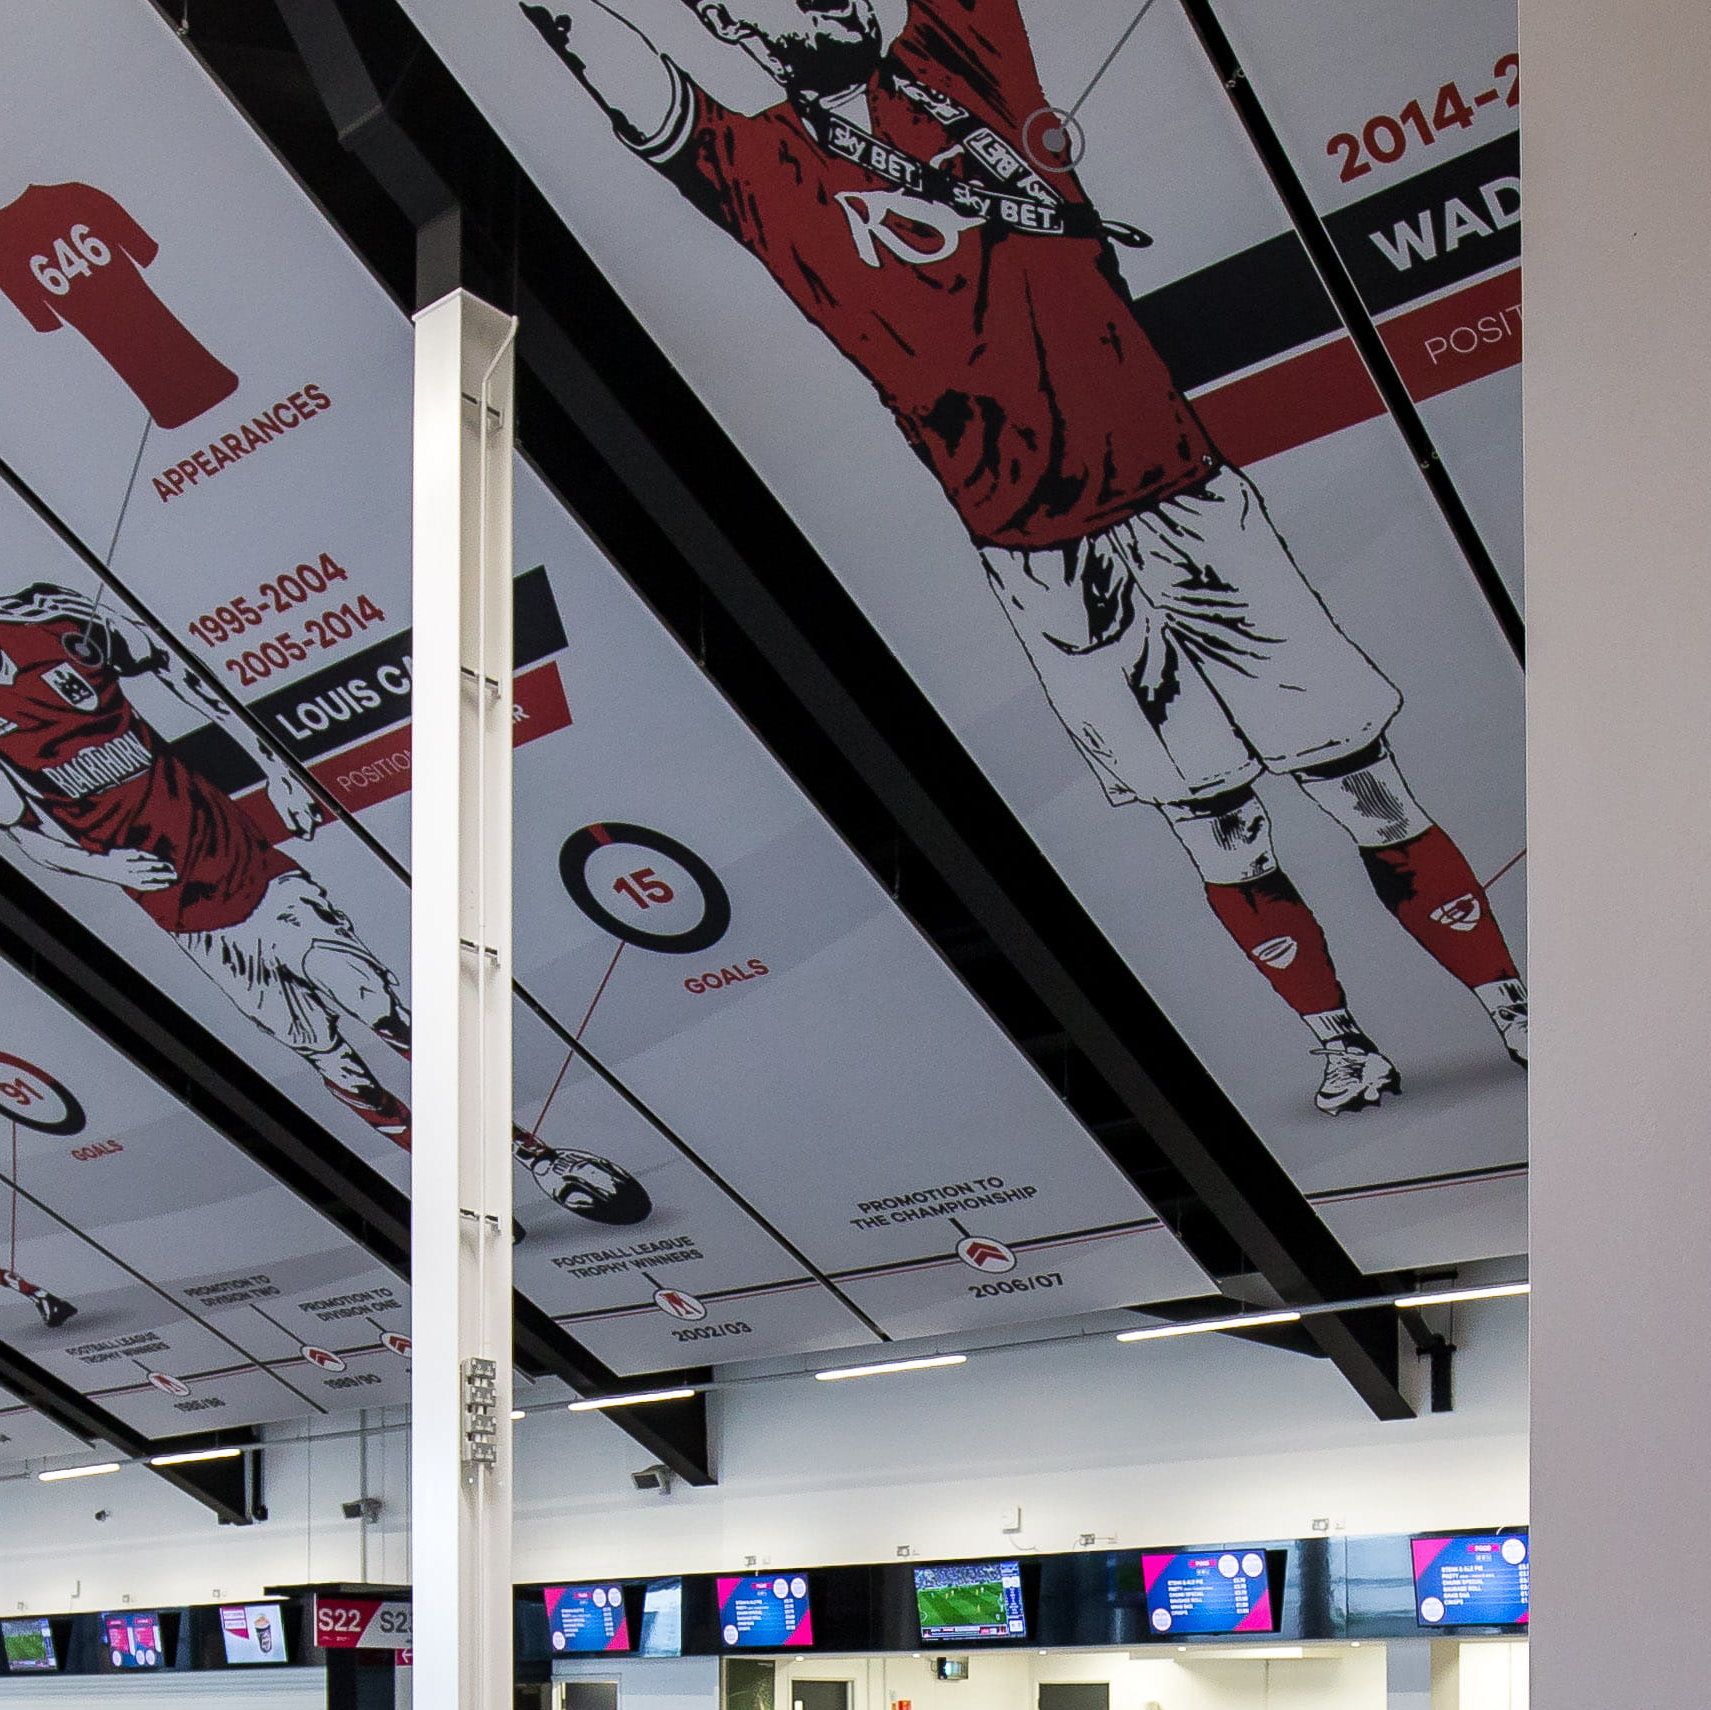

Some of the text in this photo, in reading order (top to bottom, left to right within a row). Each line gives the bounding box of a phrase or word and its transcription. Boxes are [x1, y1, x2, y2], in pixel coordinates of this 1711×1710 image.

[29, 223, 112, 295] 646
[151, 383, 332, 503] APPEARANCES
[188, 552, 348, 648] 1995-2004
[225, 593, 385, 687] 2005-2014
[276, 655, 412, 741] LOUIS C
[612, 867, 675, 910] 15
[683, 958, 770, 996] GOALS
[850, 1186, 1038, 1230] THE CHAMPIONSHIP
[857, 1176, 1004, 1214] PROMOTION TO
[552, 1236, 695, 1268] FOOTBALL LEAGUE
[567, 1249, 705, 1280] TROPHY WINNERS
[251, 1274, 271, 1285] TO
[968, 1272, 1063, 1298] 2006/07
[298, 1287, 393, 1313] PROMOTION TO
[316, 1299, 402, 1322] DIVISION ONE
[671, 1321, 752, 1344] 2002/03
[318, 1608, 362, 1632] S22
